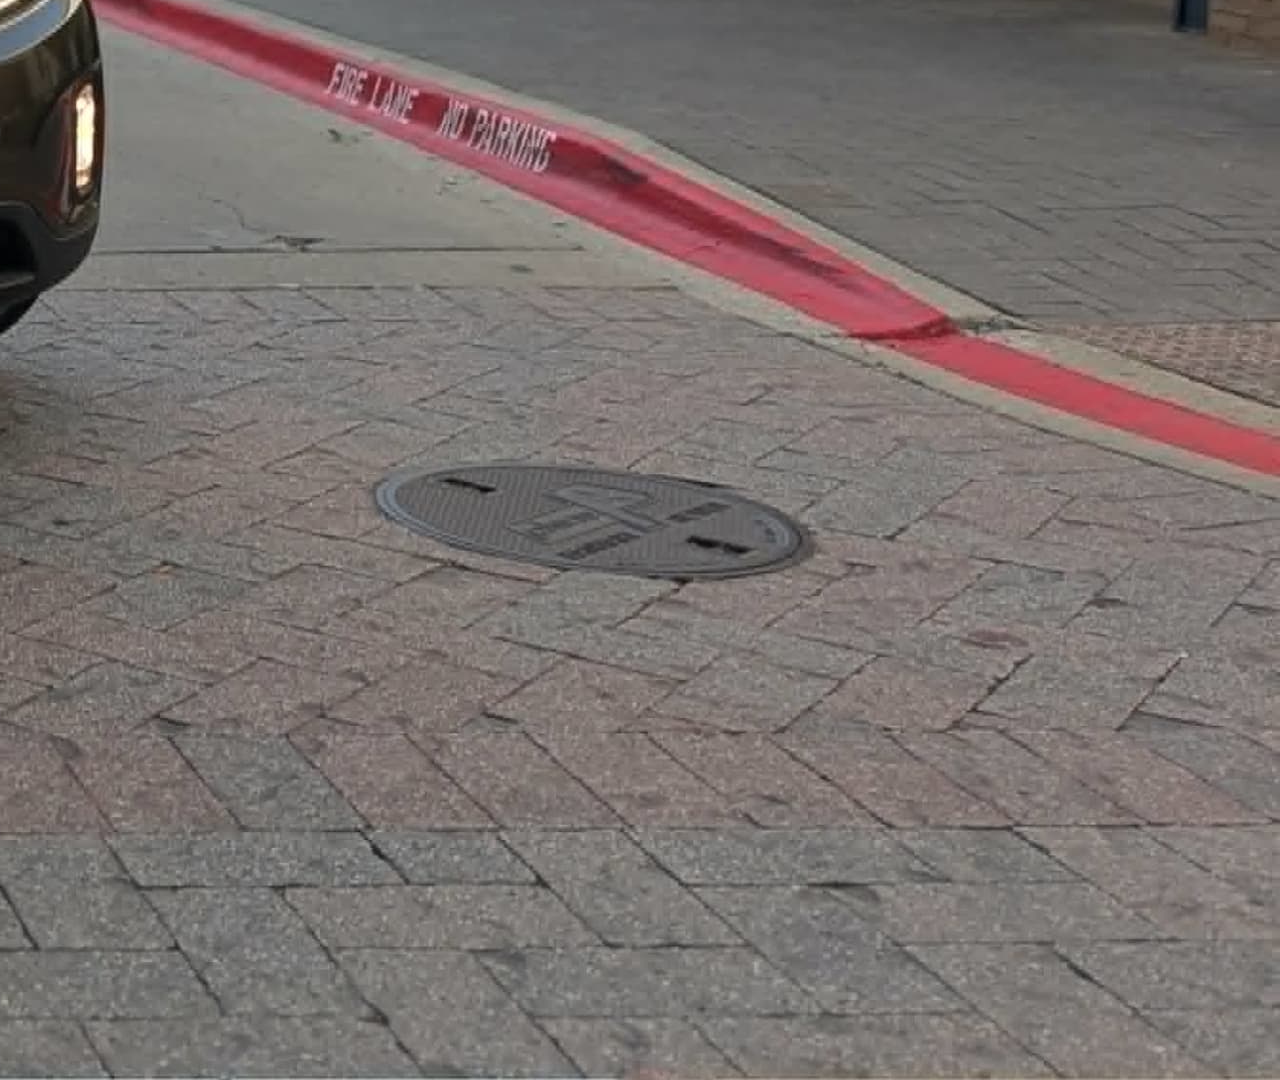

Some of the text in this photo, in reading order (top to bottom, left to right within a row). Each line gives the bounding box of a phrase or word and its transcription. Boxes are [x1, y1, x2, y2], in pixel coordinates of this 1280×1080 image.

[326, 62, 557, 172] FIRE LANE NO PARKING
